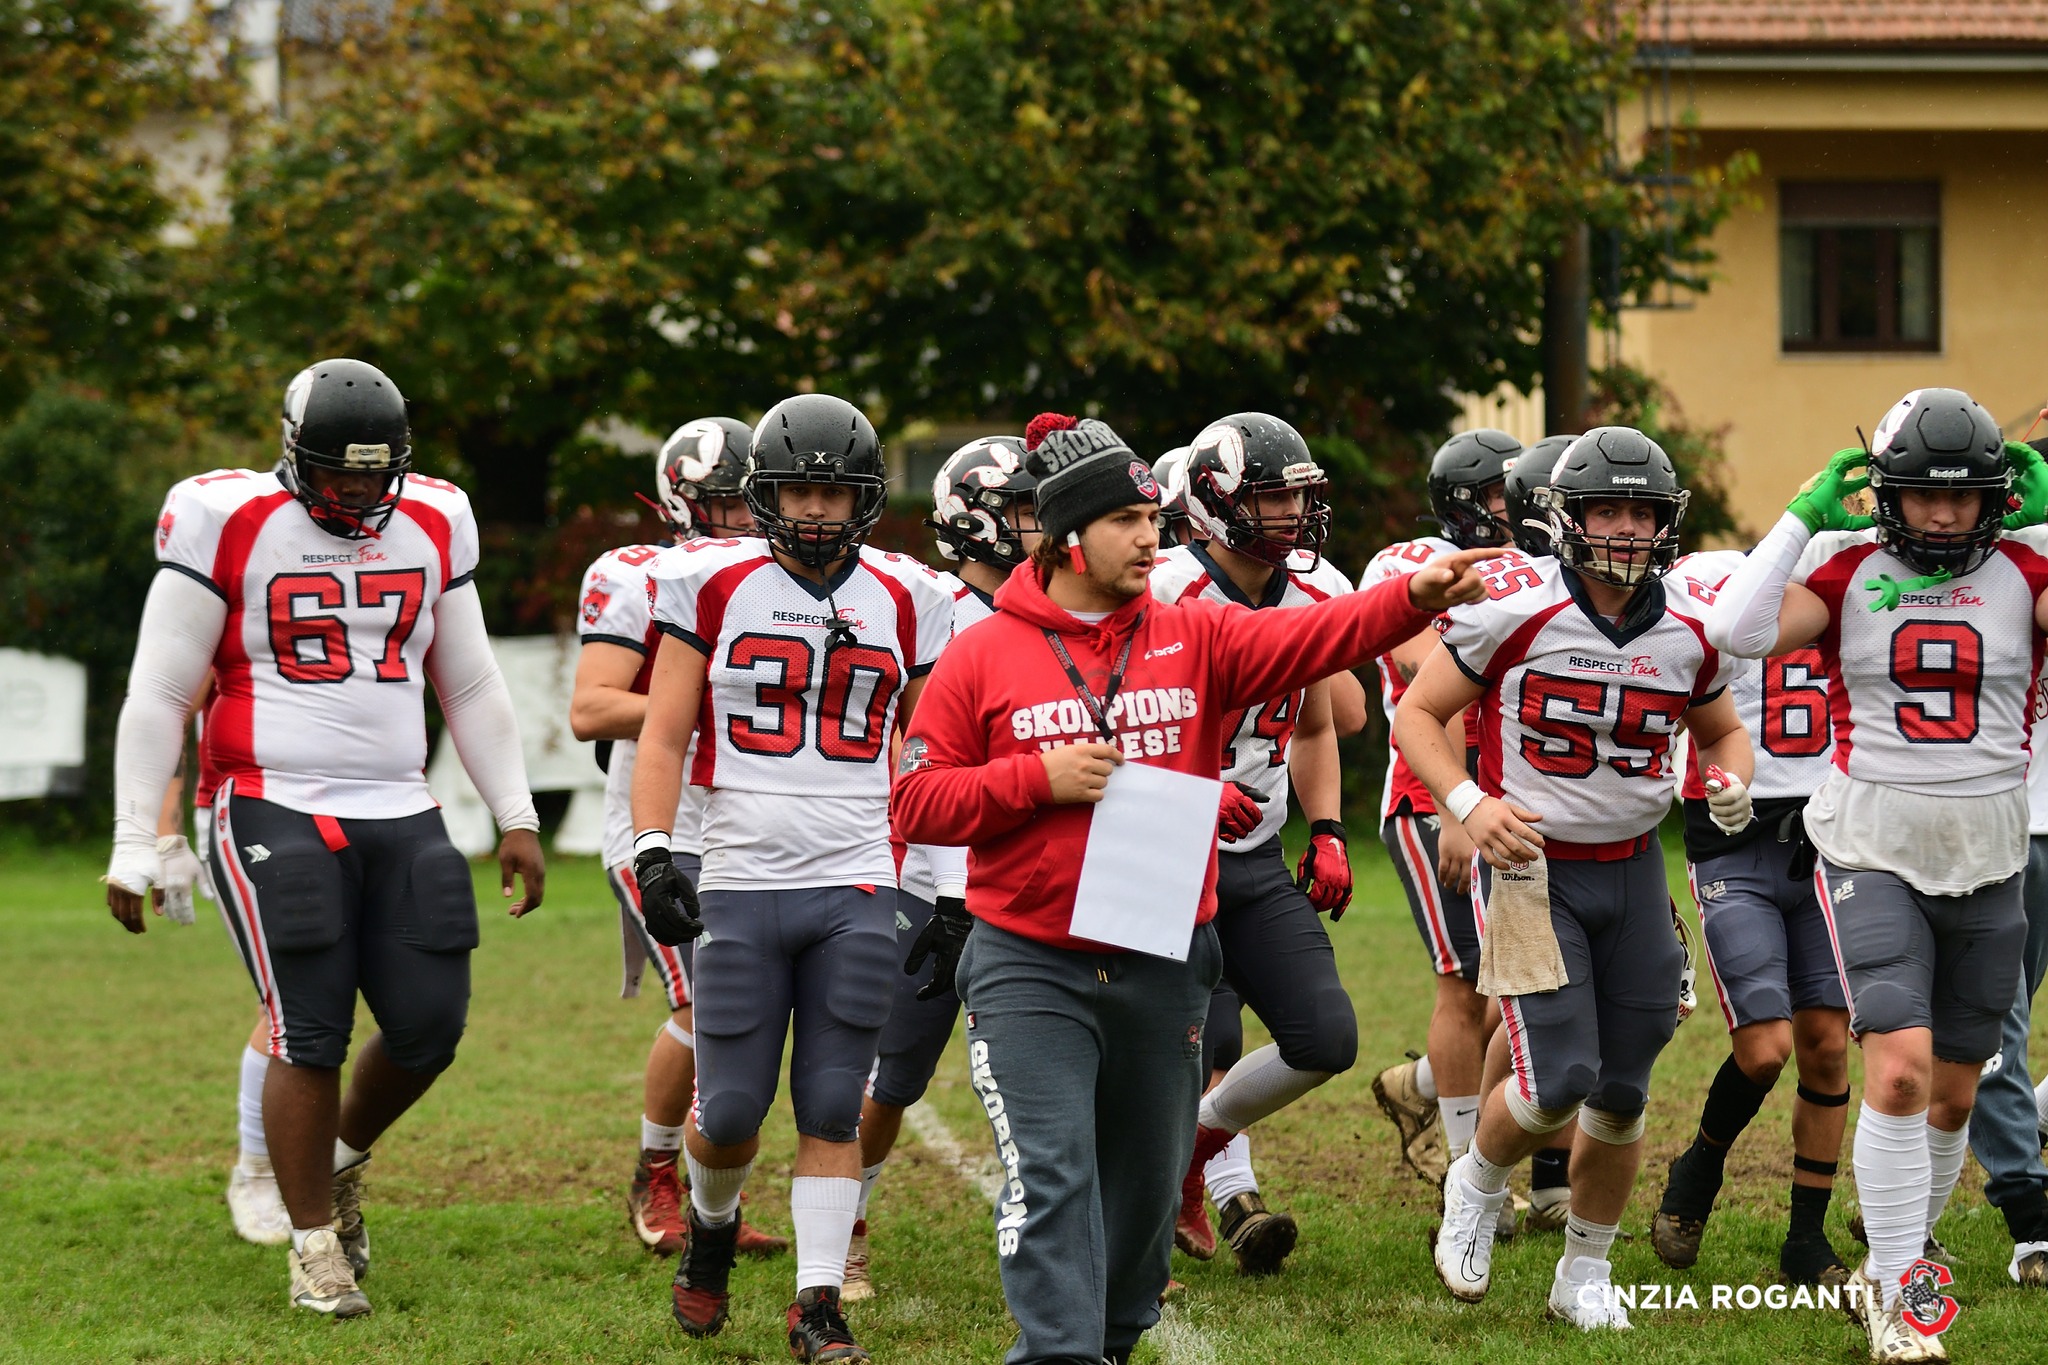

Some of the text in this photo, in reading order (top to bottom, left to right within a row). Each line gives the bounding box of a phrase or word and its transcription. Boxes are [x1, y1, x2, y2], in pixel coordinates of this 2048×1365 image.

[814, 451, 827, 464] X
[1612, 476, 1648, 486] Riddell
[1930, 468, 1968, 478] Riddell
[302, 543, 388, 563] RESPECT Fun
[1898, 593, 1943, 605] SPECT
[1951, 586, 1985, 607] Fun
[267, 567, 426, 684] 67
[772, 607, 867, 630] RESPECT Fn
[1568, 656, 1623, 673] RESPECT
[1631, 655, 1662, 677] Fun
[1889, 619, 1984, 744] 9
[726, 632, 901, 763] 30
[1760, 644, 1832, 758] 6
[1519, 669, 1690, 779] 55
[971, 1039, 1028, 1256] SKORPIONS
